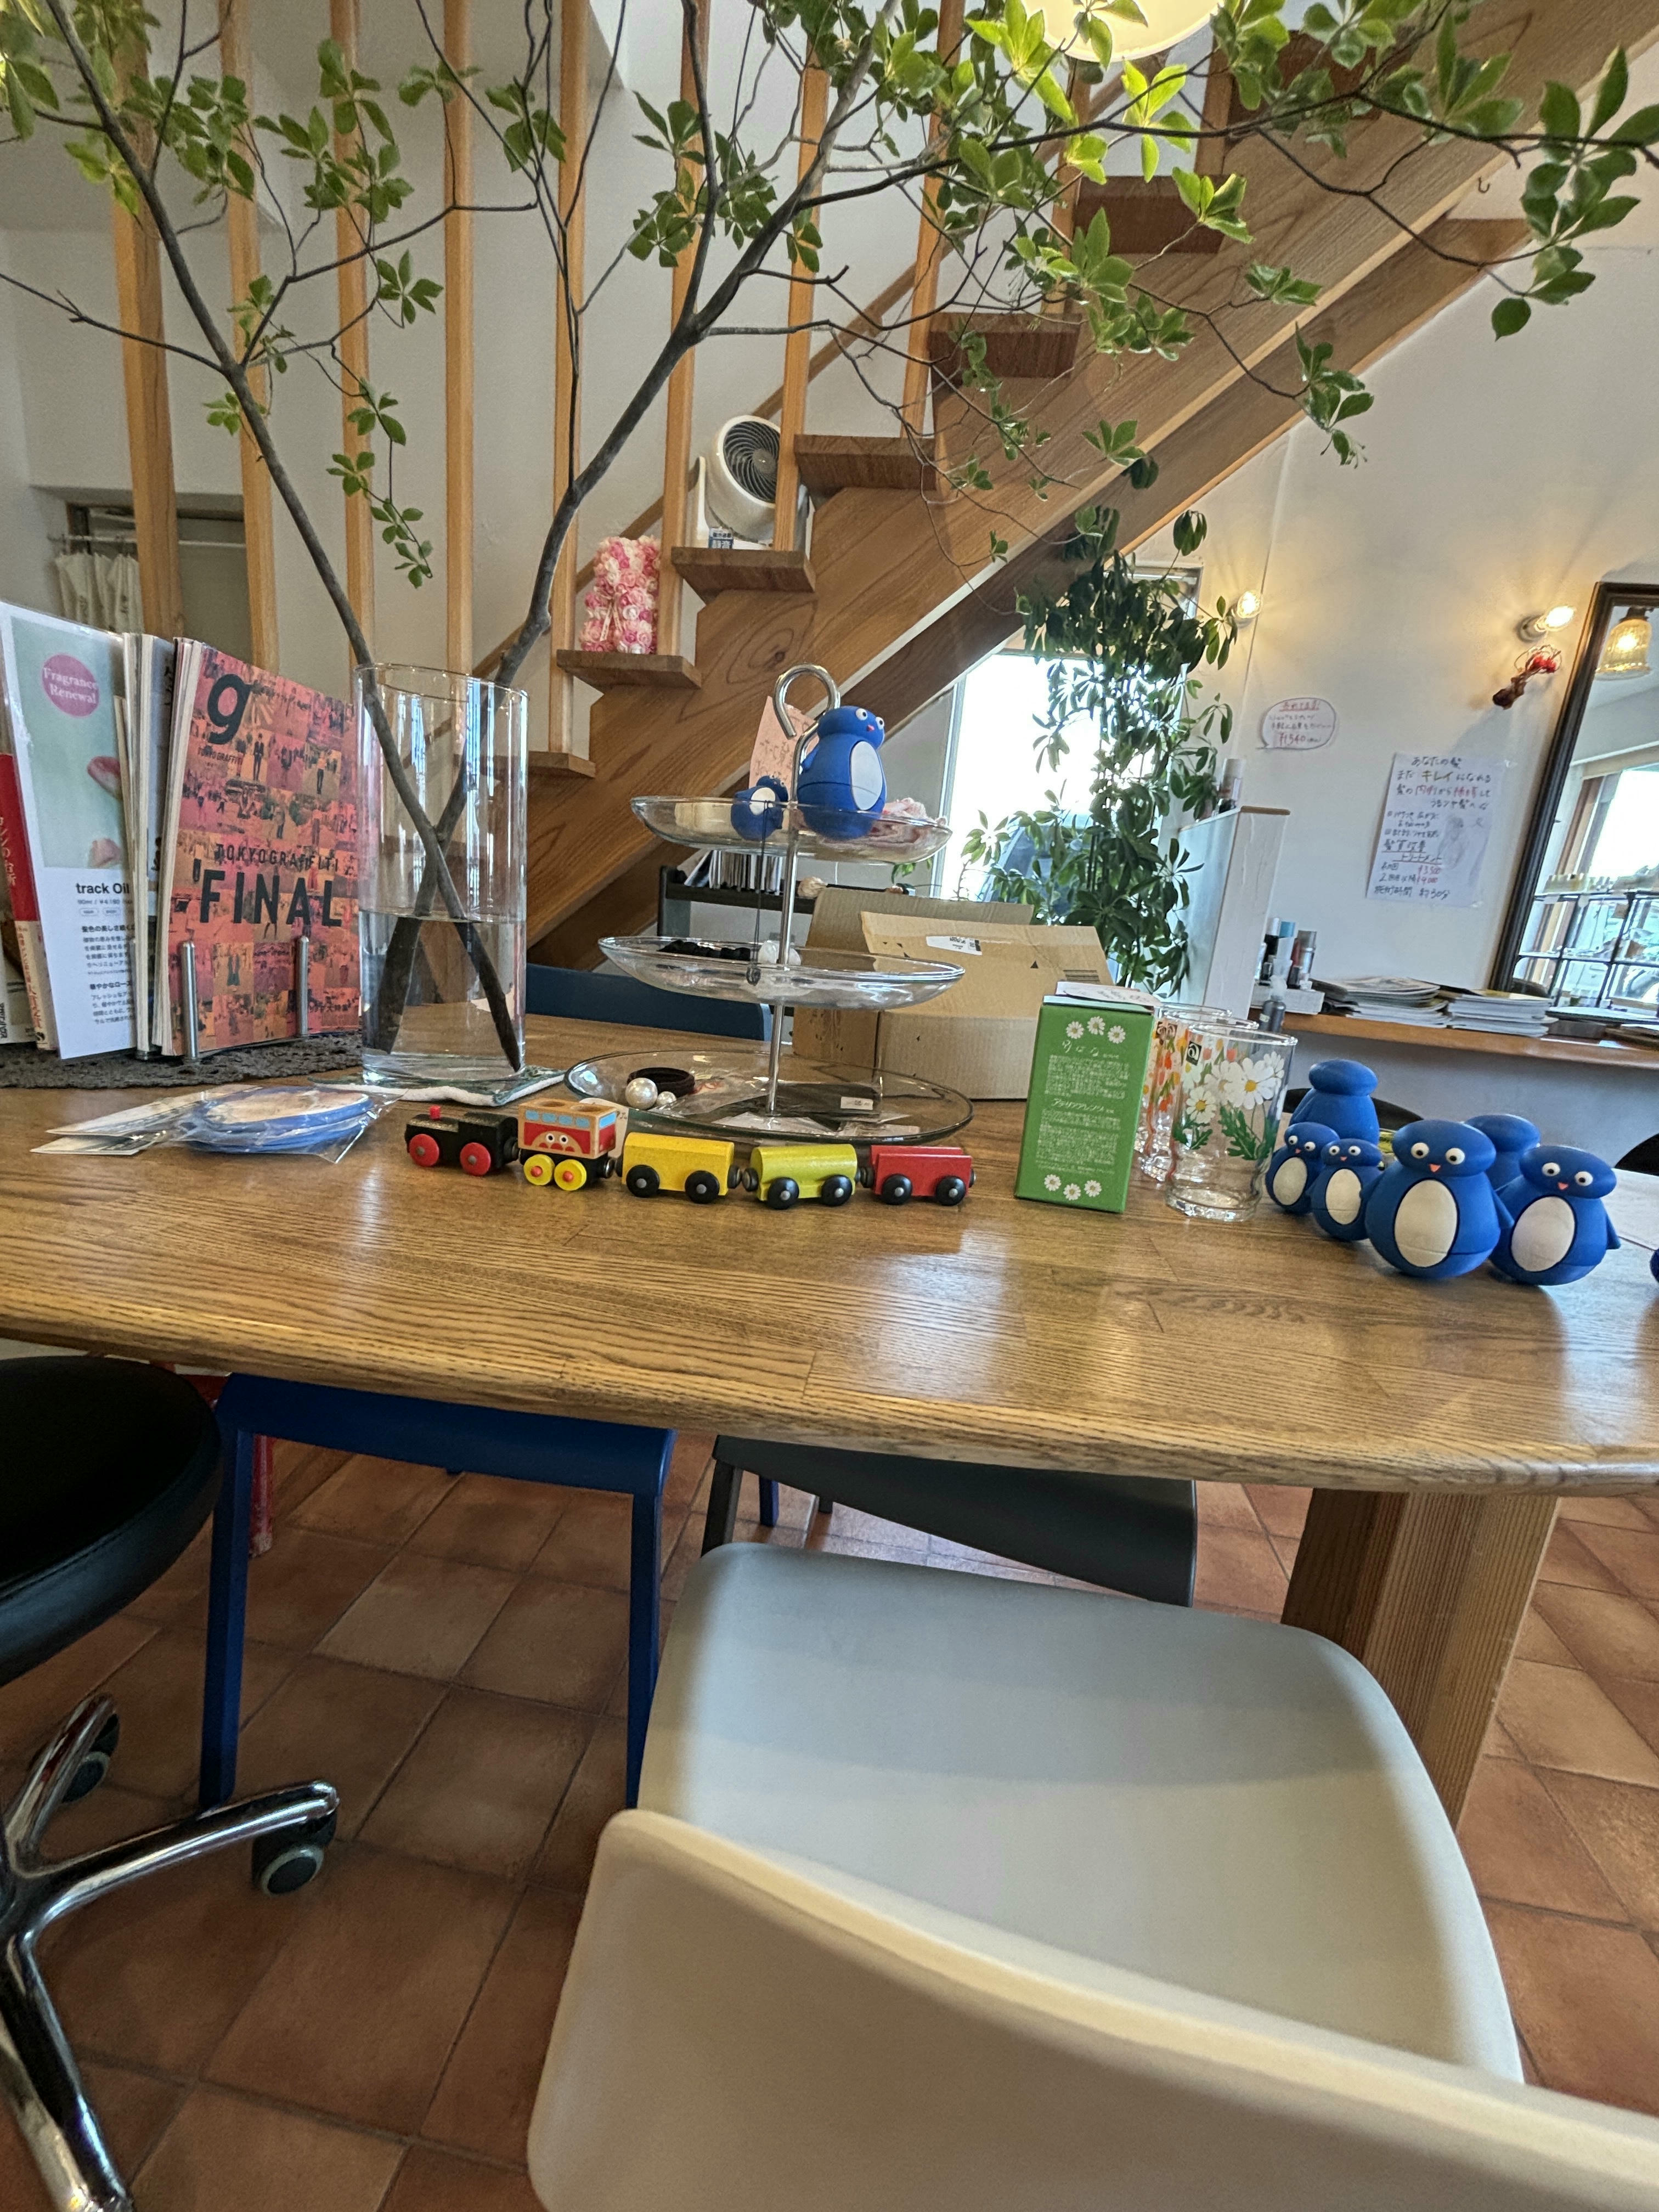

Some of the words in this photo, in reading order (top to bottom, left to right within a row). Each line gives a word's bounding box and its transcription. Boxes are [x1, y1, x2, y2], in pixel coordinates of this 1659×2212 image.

[43, 667, 98, 690] Fragrance
[49, 684, 96, 704] Renewal
[76, 882, 110, 894] track
[112, 882, 129, 894] Oil
[200, 869, 342, 927] FINAL
